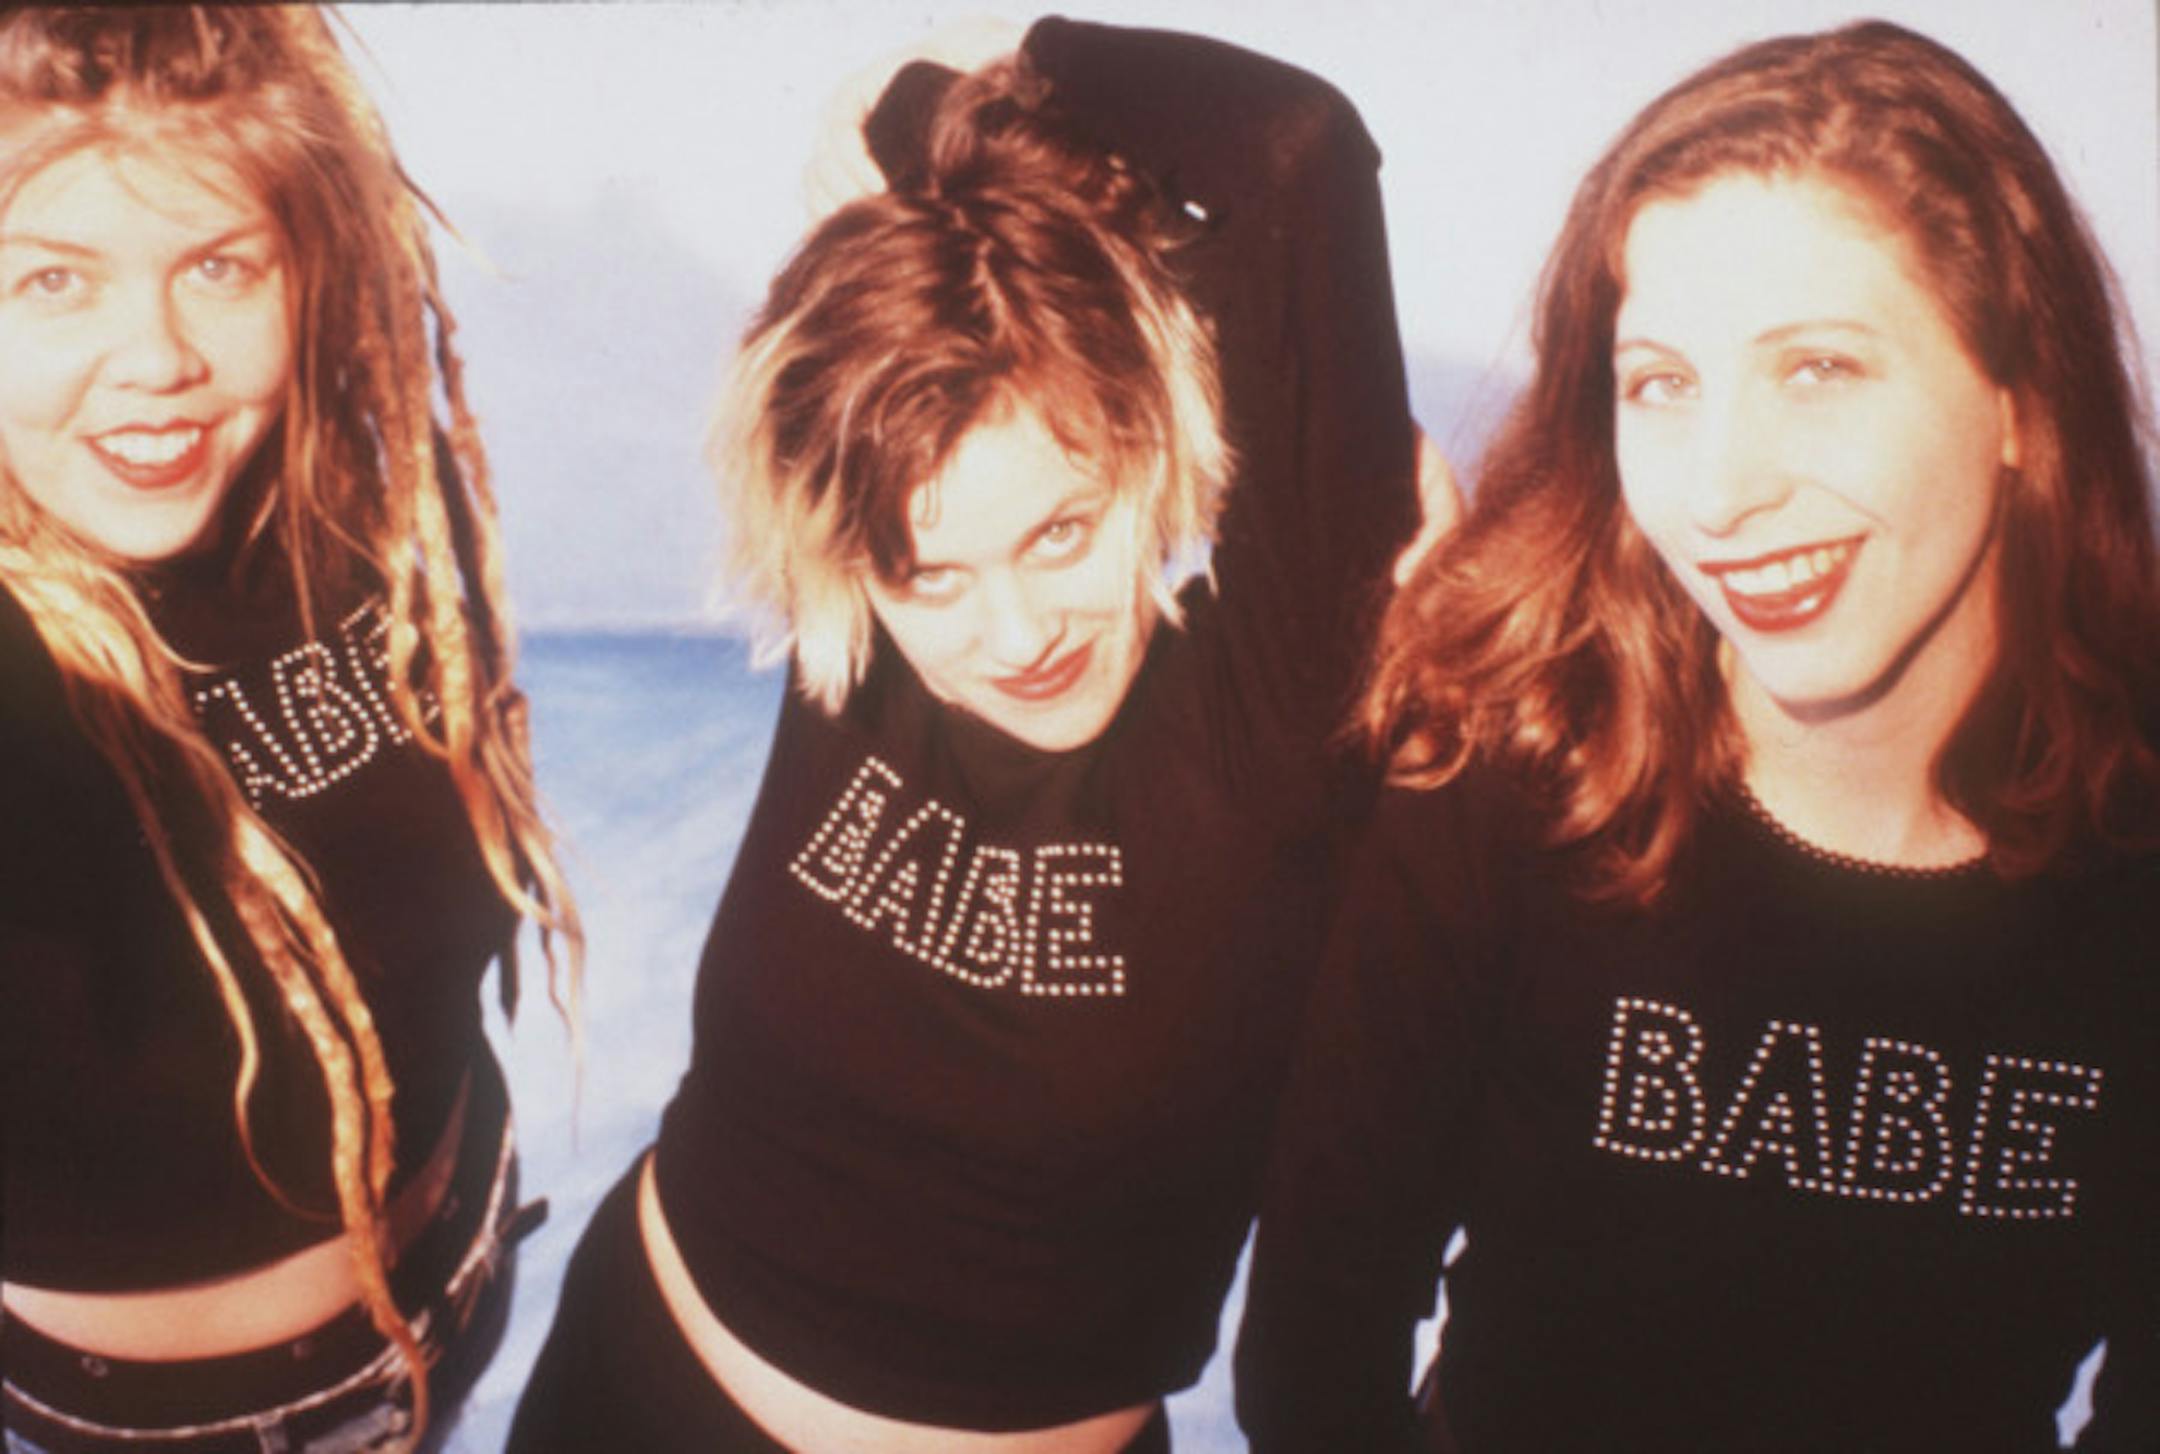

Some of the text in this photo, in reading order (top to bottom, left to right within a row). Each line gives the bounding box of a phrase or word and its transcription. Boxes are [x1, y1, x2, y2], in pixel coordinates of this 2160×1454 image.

[194, 595, 440, 811] ABE
[788, 756, 1126, 997] BABE
[1593, 997, 2103, 1220] BABE
